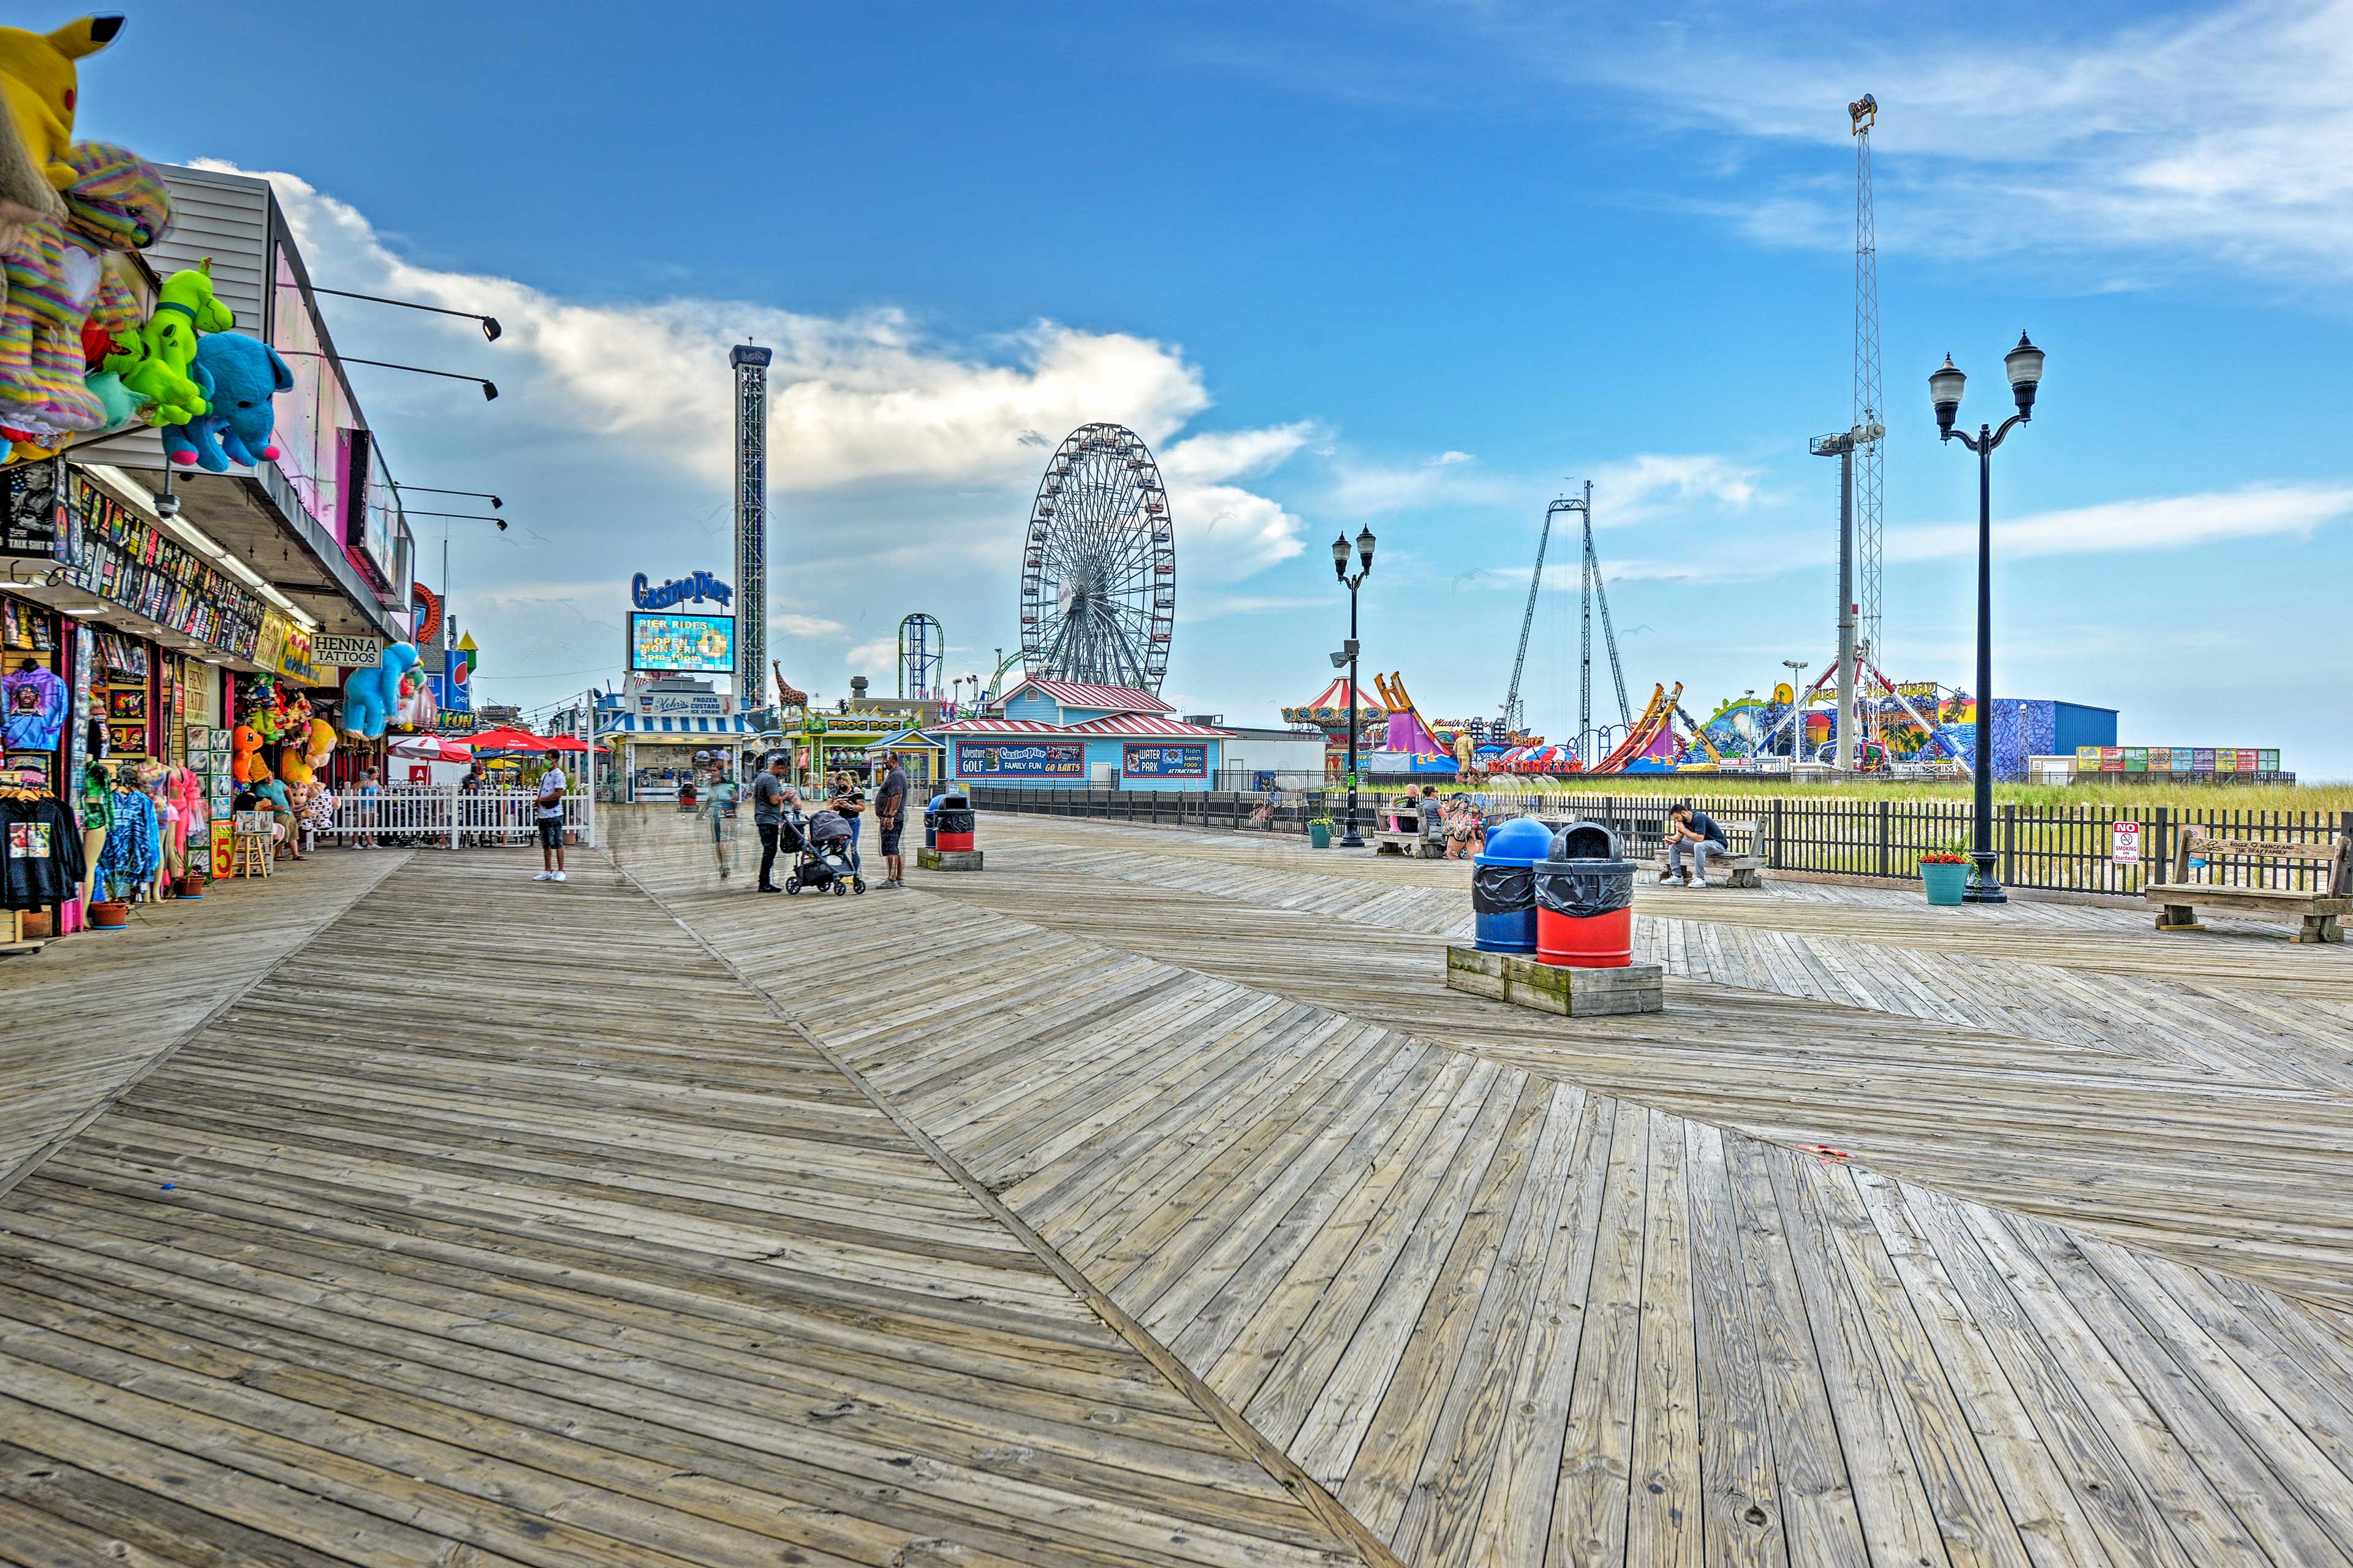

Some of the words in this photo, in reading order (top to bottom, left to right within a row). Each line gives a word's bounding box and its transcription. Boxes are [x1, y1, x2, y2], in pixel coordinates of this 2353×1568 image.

[8, 539, 27, 549] TALK
[639, 619, 667, 628] PIER
[672, 620, 707, 629] RIDES
[314, 637, 377, 652] HENNA
[654, 637, 688, 646] OPEN
[676, 645, 695, 654] FRI
[317, 651, 374, 662] TATTOOS
[445, 711, 474, 728] FUN
[828, 720, 867, 730] FROG
[869, 720, 901, 731] BOG
[961, 747, 985, 759] Adventure
[1139, 749, 1160, 760] WATER
[963, 760, 984, 773] GOLF
[1045, 763, 1055, 772] GO
[1056, 763, 1080, 772] KARTS
[1142, 762, 1158, 772] PARK
